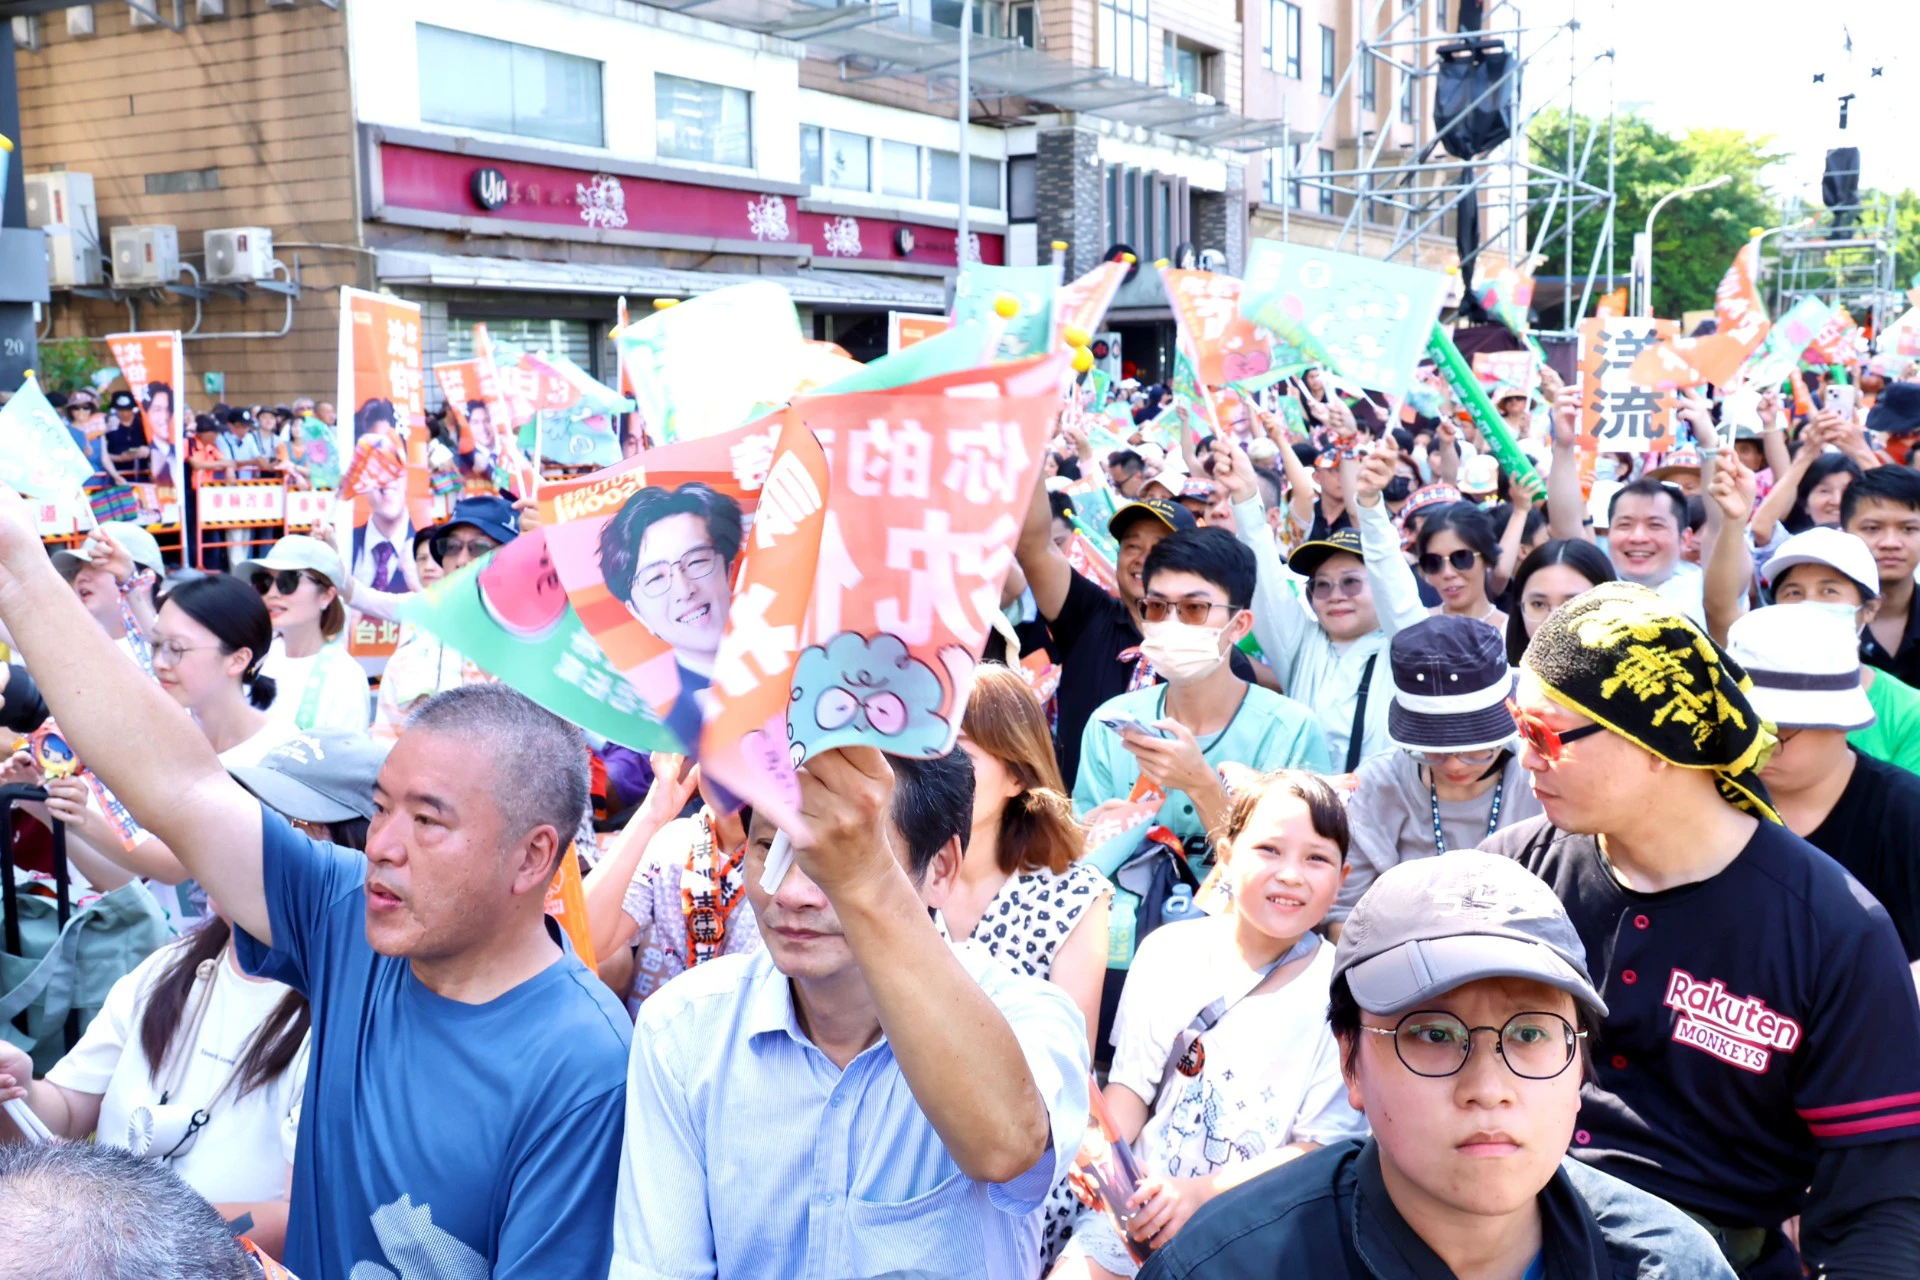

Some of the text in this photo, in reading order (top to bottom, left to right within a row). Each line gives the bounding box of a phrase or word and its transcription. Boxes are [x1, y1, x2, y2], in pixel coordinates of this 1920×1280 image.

[481, 170, 508, 205] Yu
[4, 338, 24, 356] 20
[1590, 329, 1665, 439] 洋流
[355, 619, 399, 644] 台北
[1669, 974, 1796, 1046] Rakuten
[1678, 1022, 1765, 1068] MONKEYS
